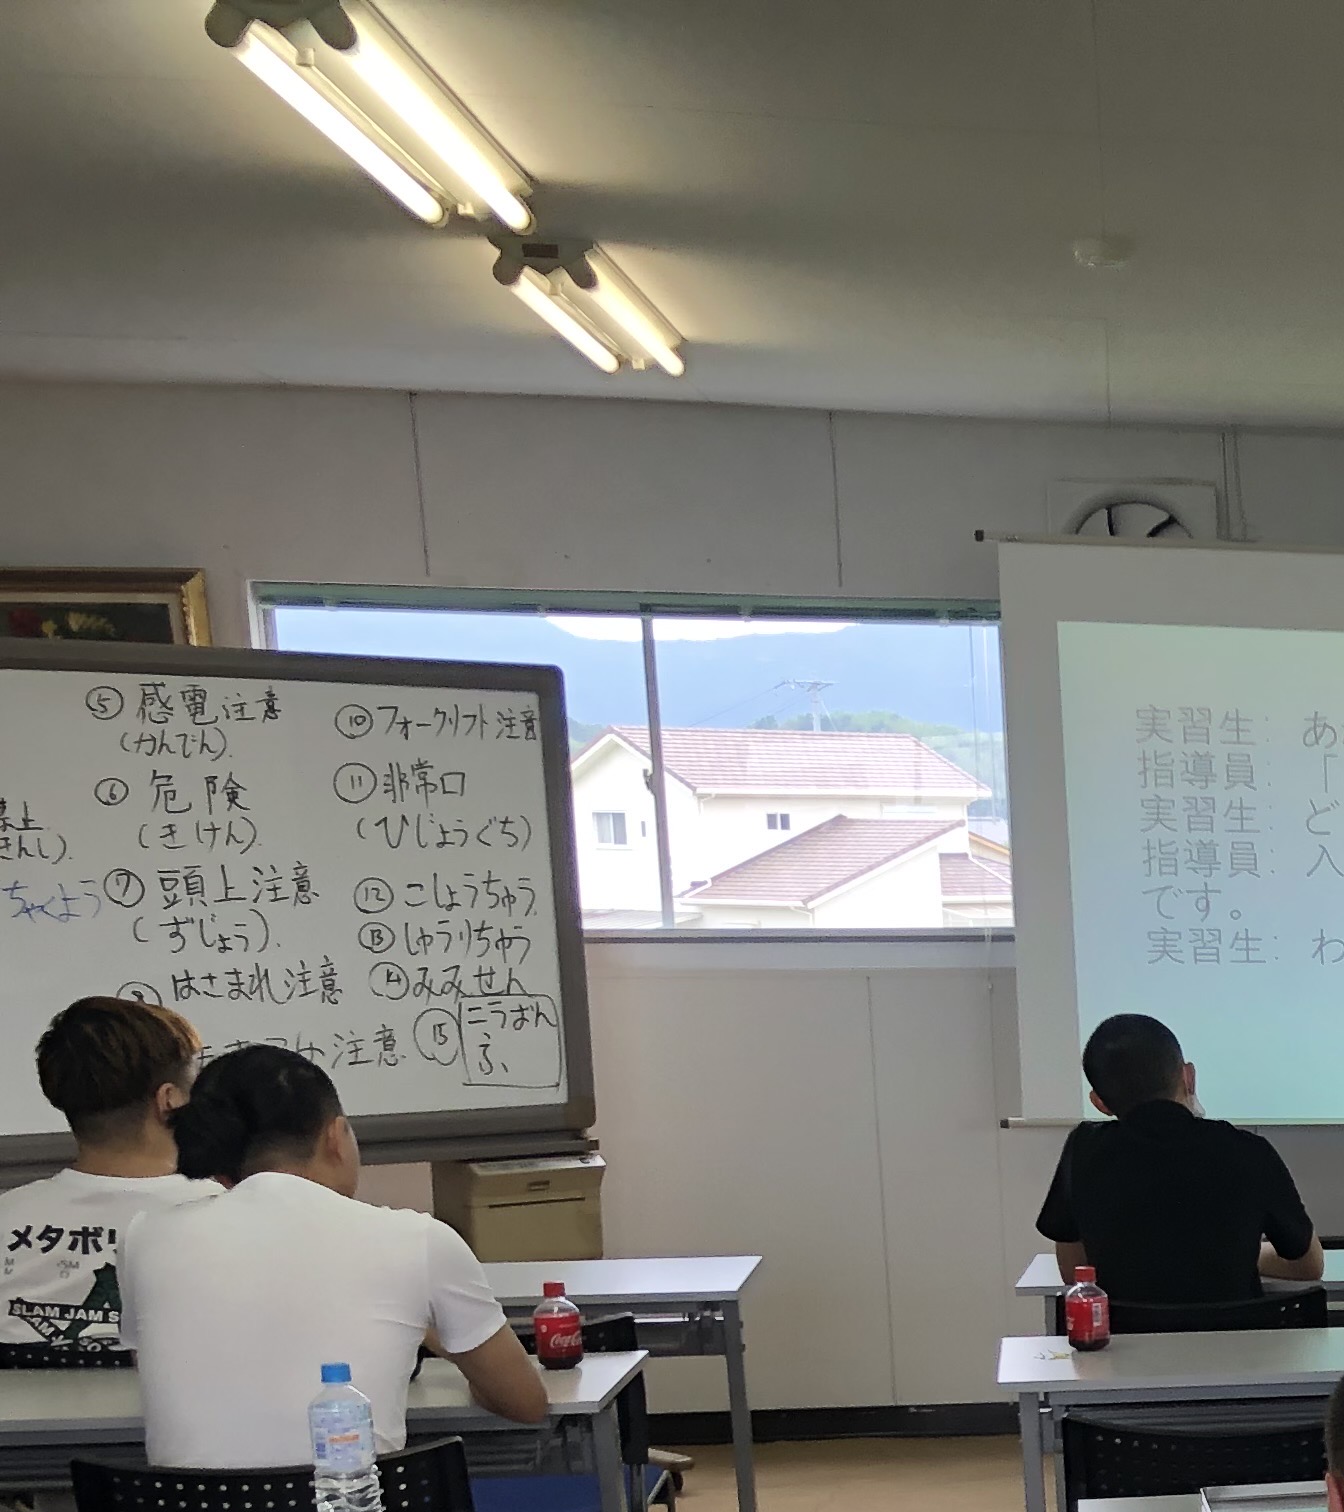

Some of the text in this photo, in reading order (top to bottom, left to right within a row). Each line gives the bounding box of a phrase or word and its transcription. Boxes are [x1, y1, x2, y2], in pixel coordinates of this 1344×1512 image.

[136, 681, 282, 725] 感電注意
[149, 769, 251, 816] 危険
[383, 757, 466, 809] 非常口
[157, 860, 321, 911] 頭上注意
[1142, 882, 1243, 922] です。
[171, 955, 343, 1006] はさまれ注意
[12, 1303, 60, 1318] SLAM
[64, 1308, 104, 1322] JAM
